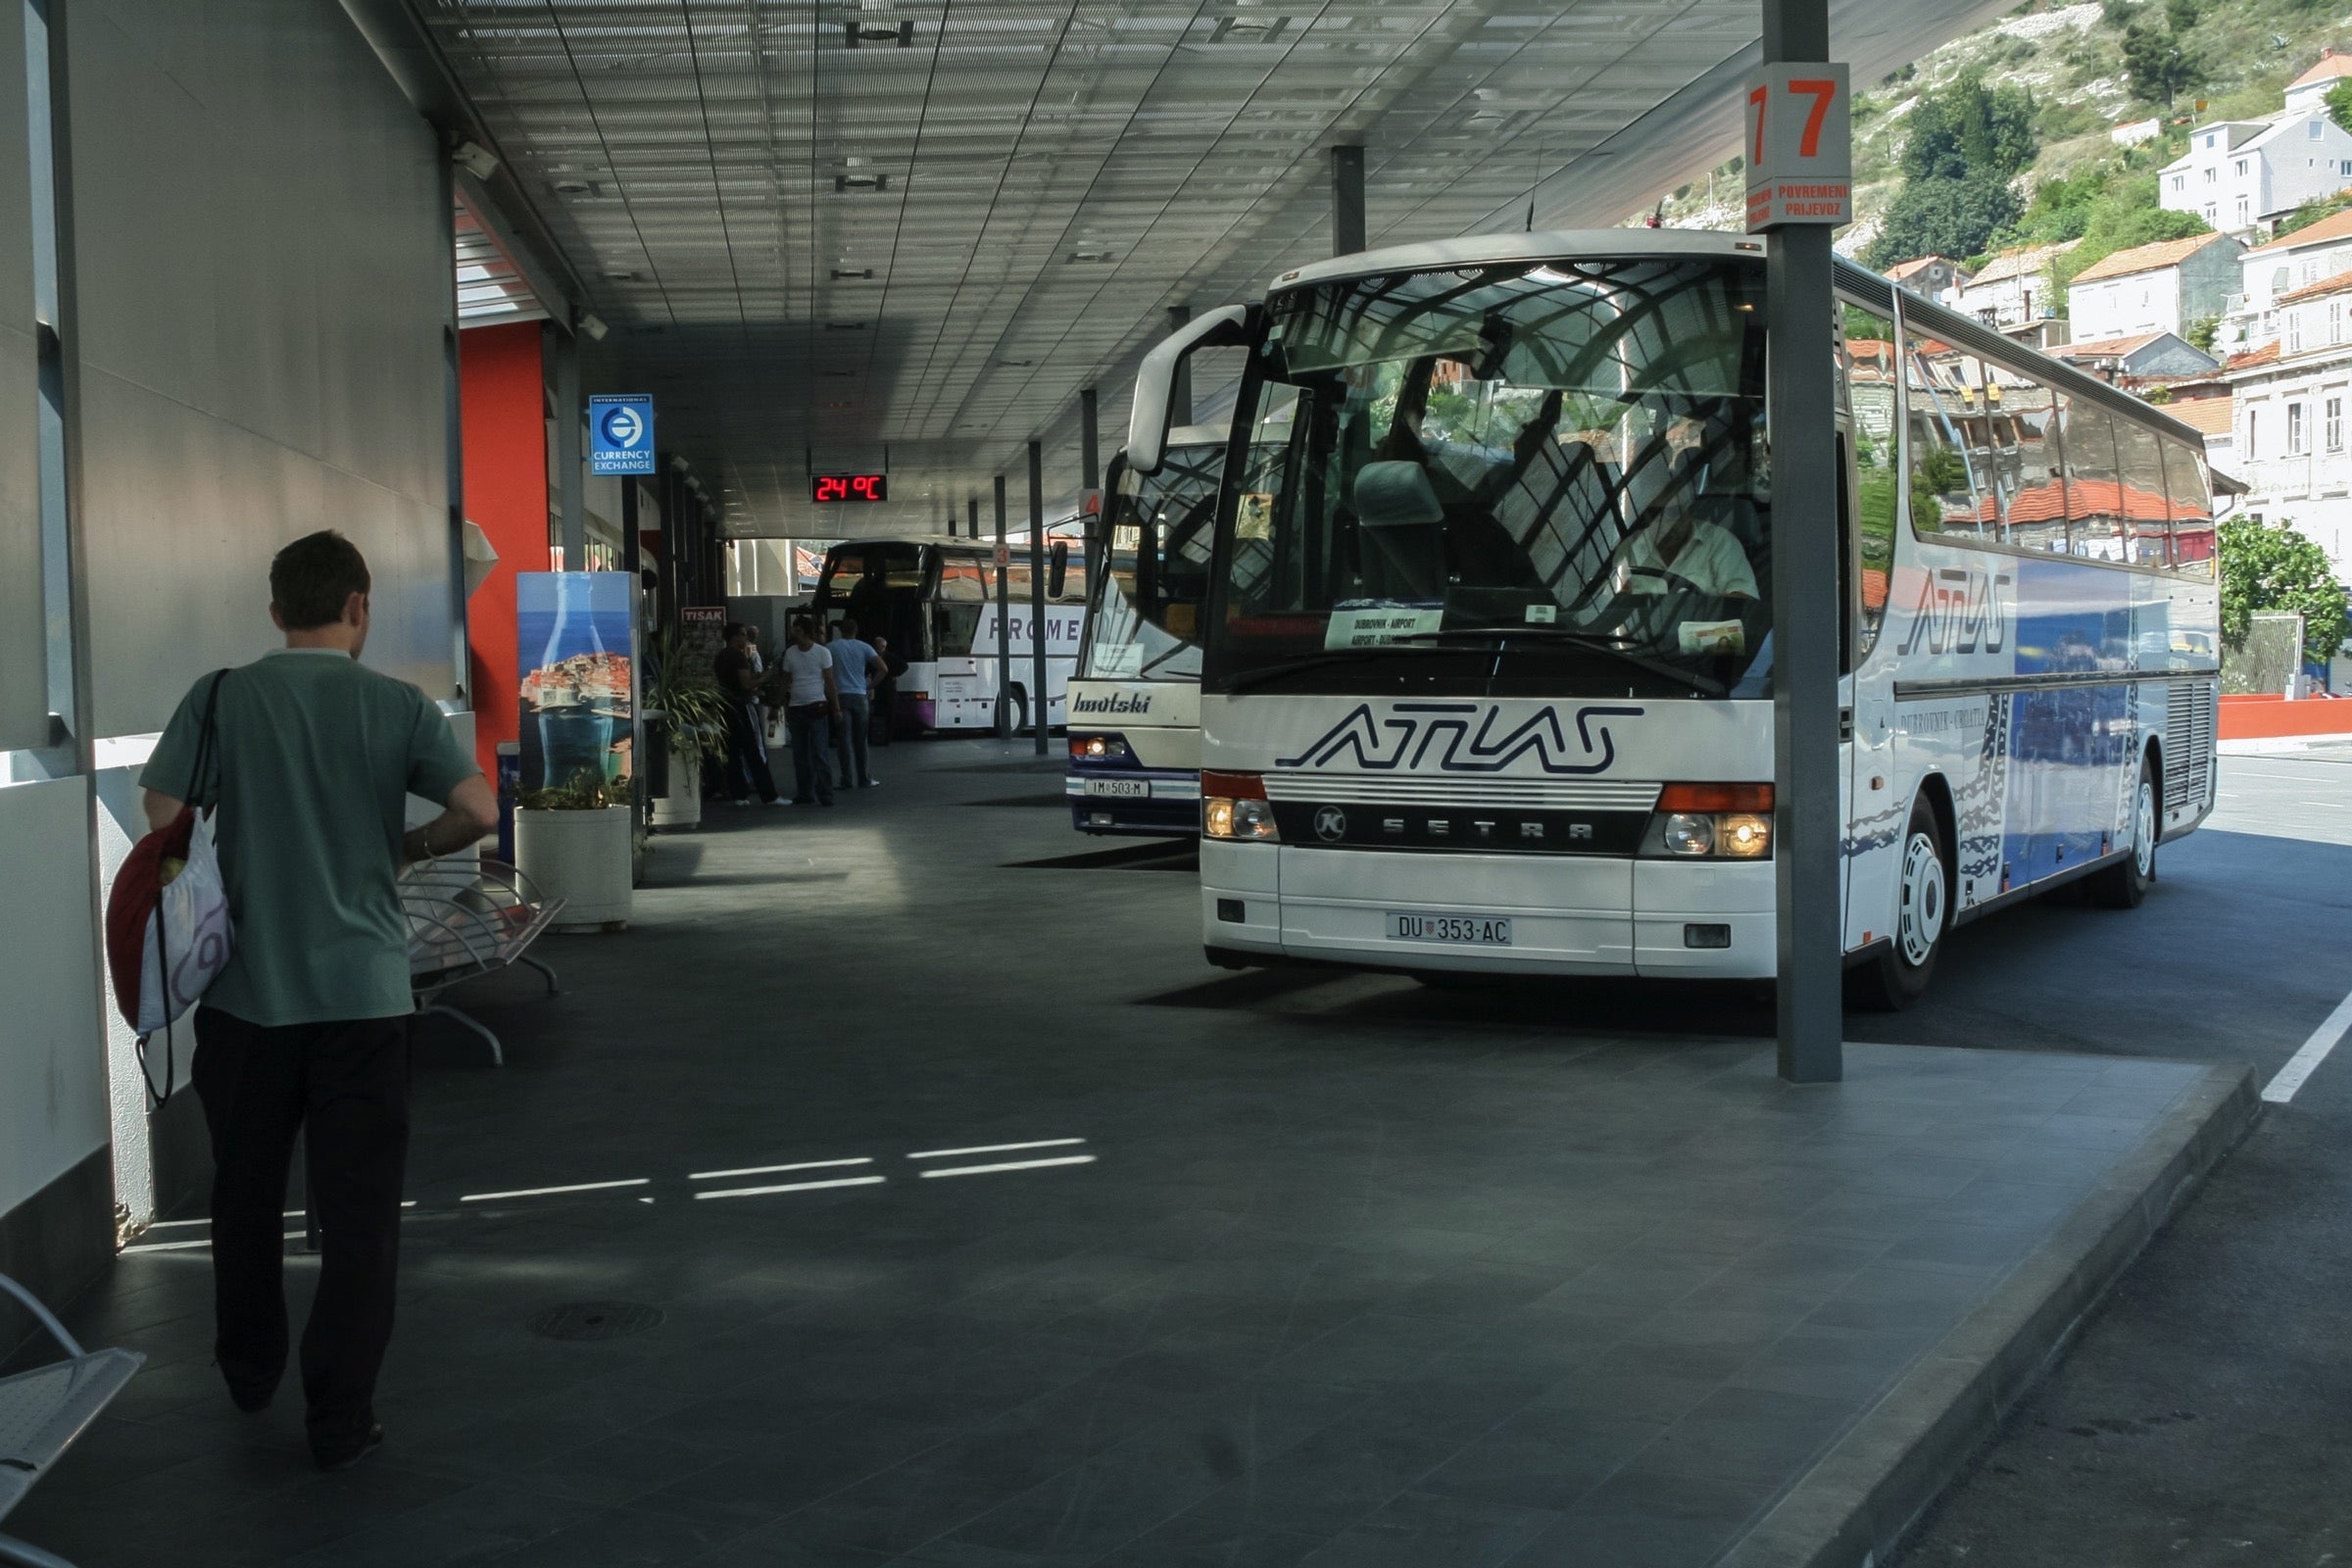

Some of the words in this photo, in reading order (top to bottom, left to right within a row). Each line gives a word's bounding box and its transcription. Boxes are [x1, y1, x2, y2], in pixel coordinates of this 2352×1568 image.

[1788, 80, 1836, 157] 7
[1778, 184, 1847, 198] POVREMENI
[1786, 202, 1841, 216] PRIJEVOZ
[594, 450, 651, 461] CURRENCY
[594, 461, 651, 470] EXCHANGE
[816, 477, 847, 501] 24
[1086, 493, 1101, 513] 4
[997, 548, 1007, 564] 3
[685, 611, 723, 620] TISAK
[1896, 567, 2010, 656] ATLAS
[1391, 617, 1416, 628] AIRPORT
[1072, 692, 1152, 713] Imotski
[1901, 710, 1949, 735] DUBROVNIK
[1954, 708, 1985, 729] CROATIA
[1274, 704, 1645, 774] ATLAS
[1094, 781, 1105, 793] IM
[1383, 818, 1592, 839] SETRA
[1398, 916, 1423, 937] DU
[1438, 918, 1507, 942] 353-AC
